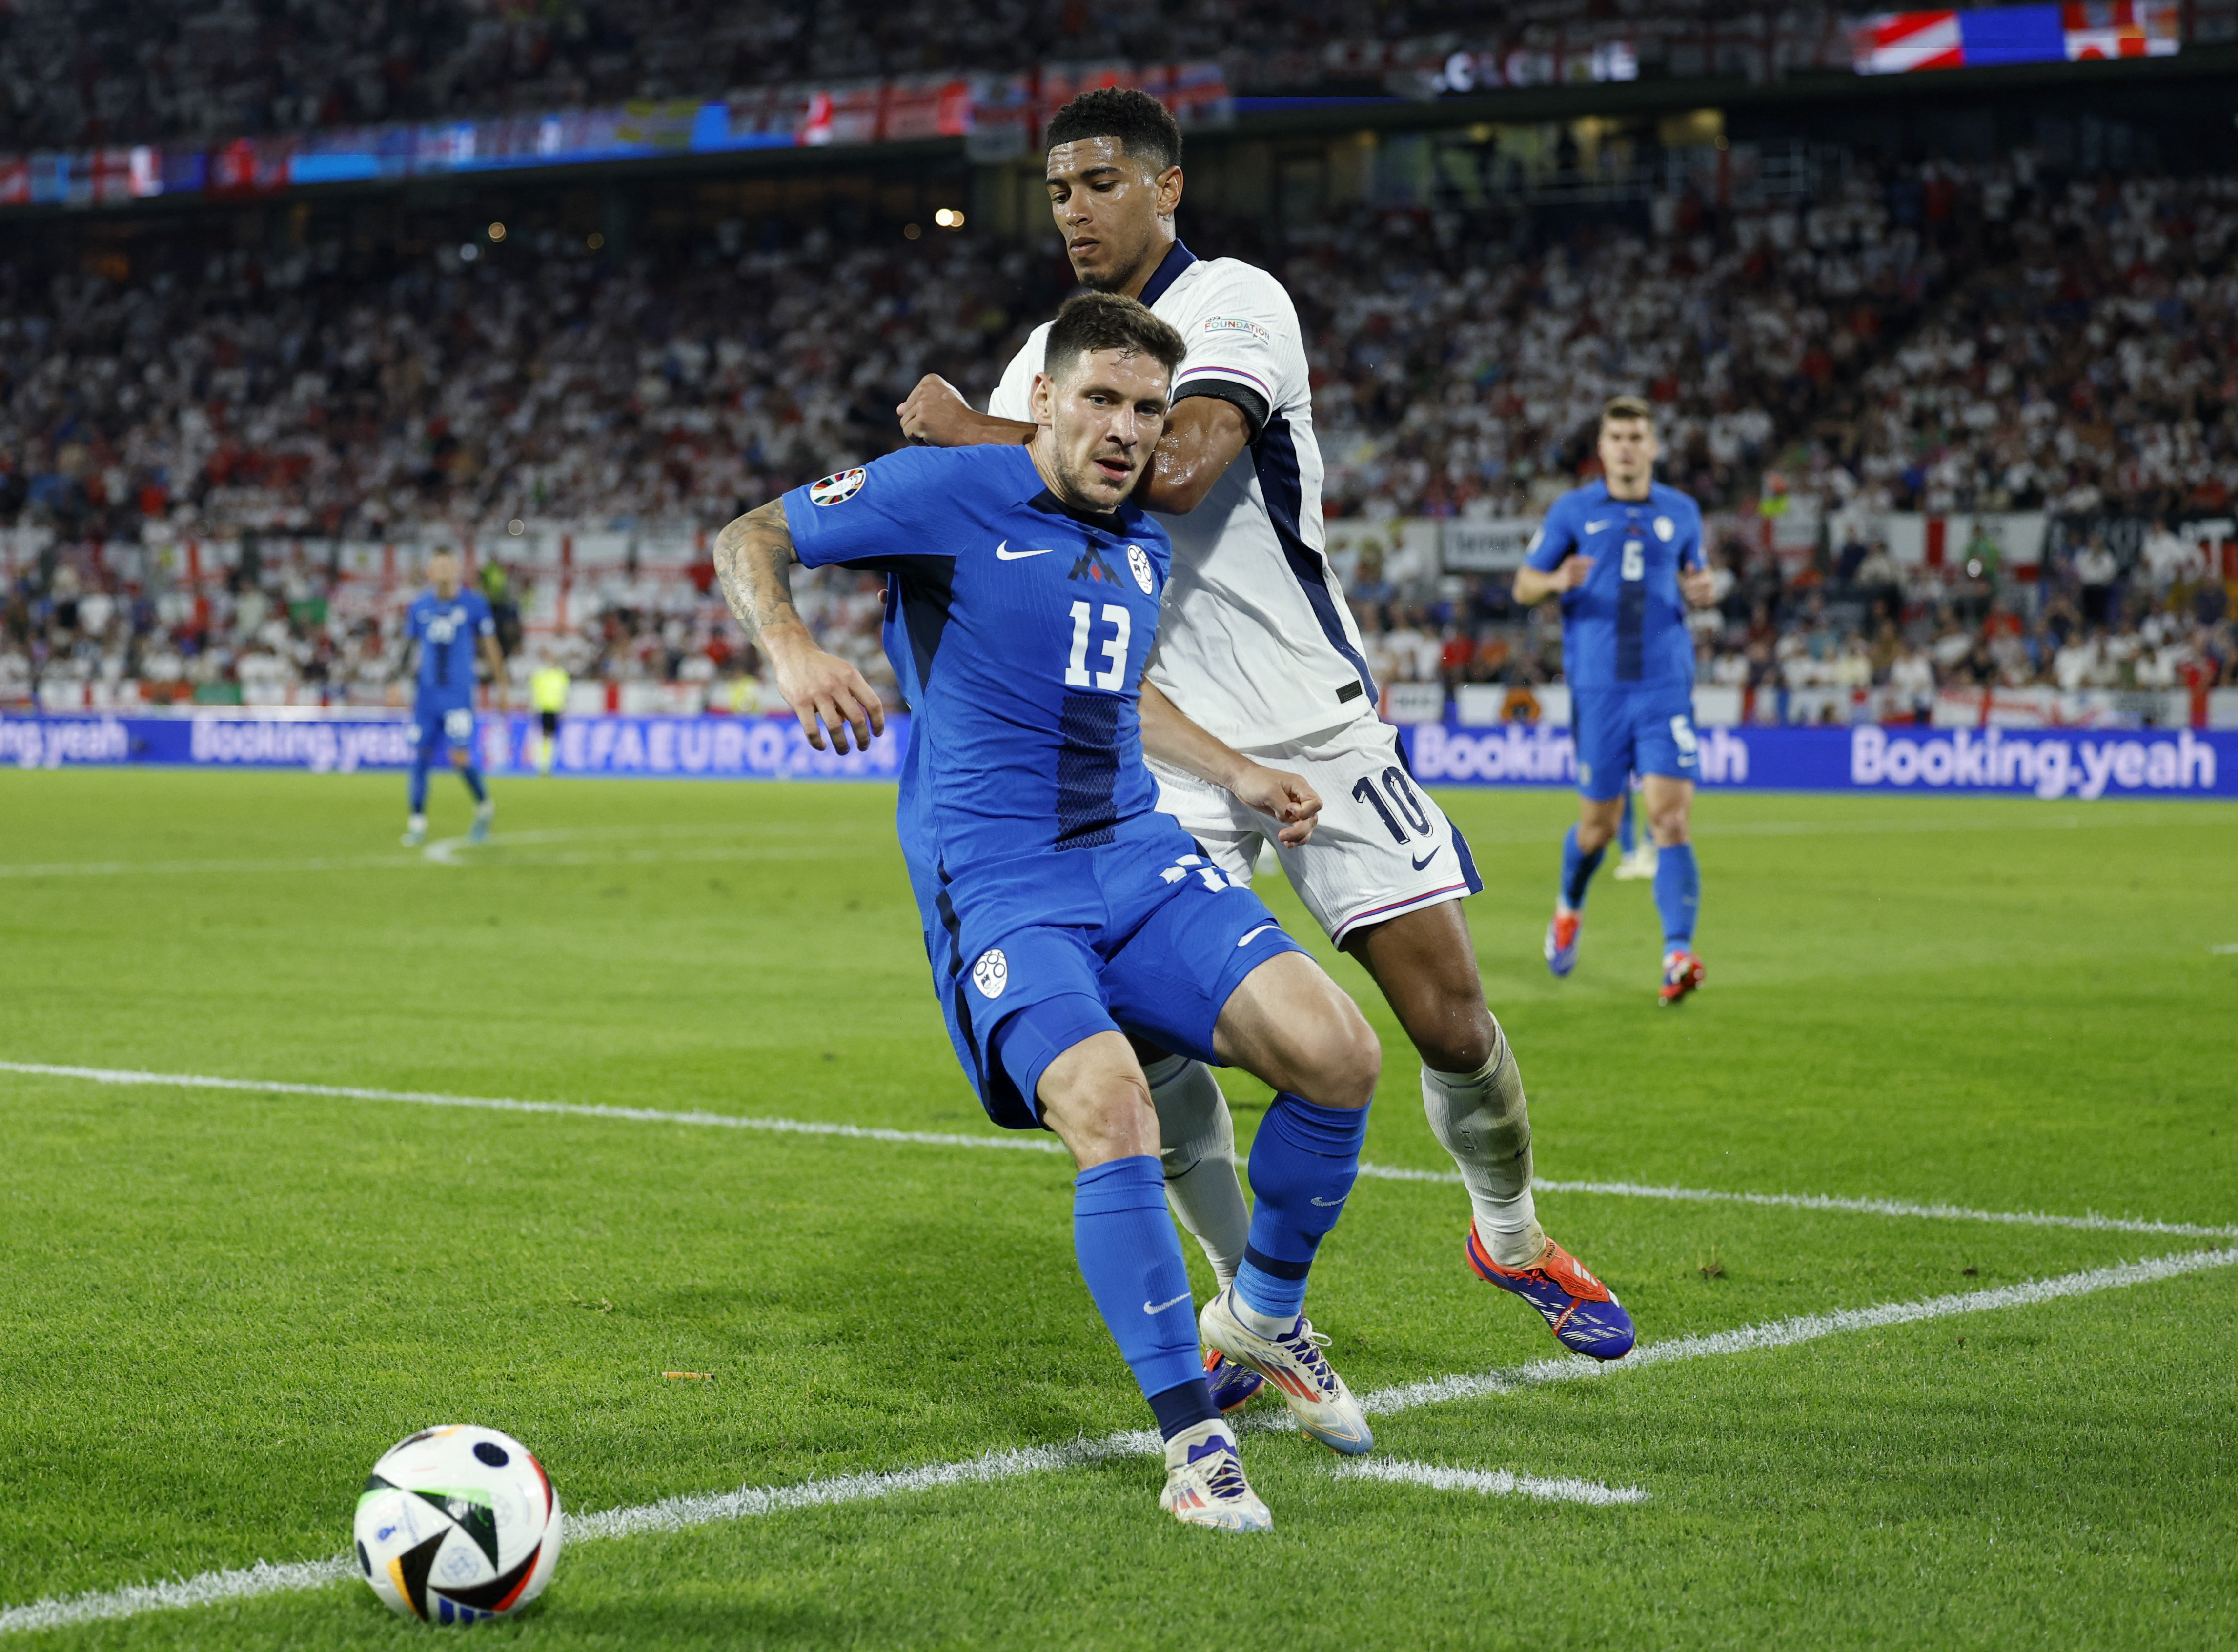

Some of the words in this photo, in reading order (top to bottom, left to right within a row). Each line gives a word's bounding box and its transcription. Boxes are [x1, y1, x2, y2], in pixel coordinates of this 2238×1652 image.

[1205, 321, 1269, 340] FOUNDATION
[1621, 539, 1645, 582] 6
[1065, 601, 1131, 692] 13
[0, 713, 129, 770] ng.yeah
[1852, 725, 2217, 800] Booking.yeah
[1352, 766, 1433, 845] 10
[1554, 1306, 1575, 1331] PREDATOR
[1232, 1336, 1284, 1365] F50
[1169, 1480, 1190, 1495] F50
